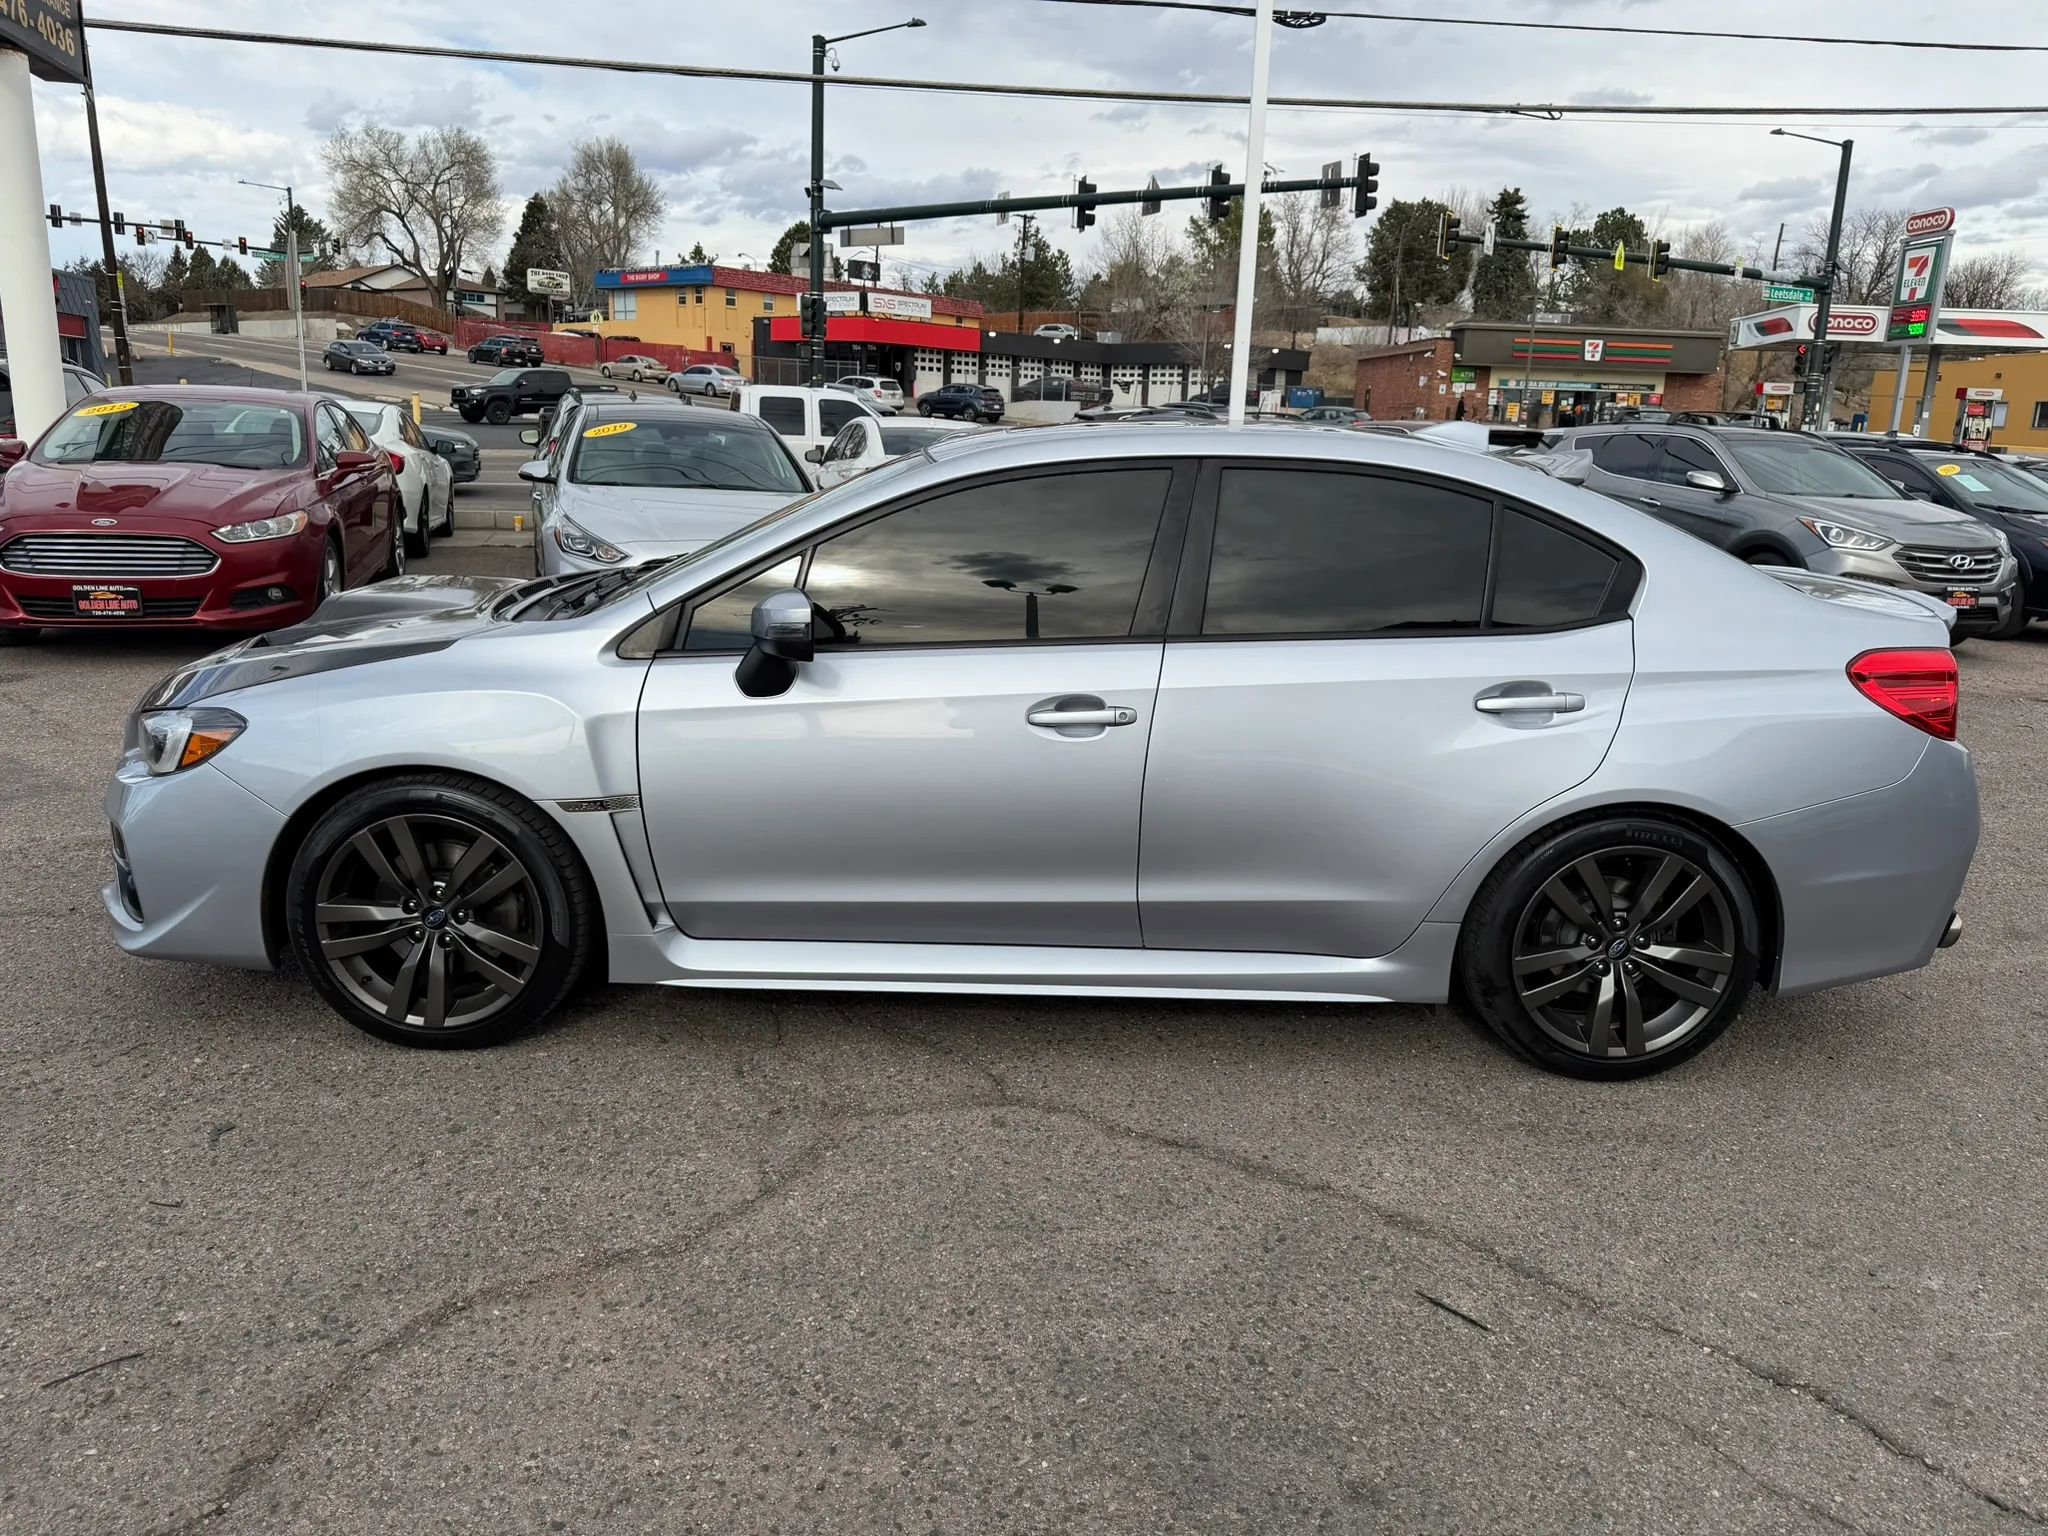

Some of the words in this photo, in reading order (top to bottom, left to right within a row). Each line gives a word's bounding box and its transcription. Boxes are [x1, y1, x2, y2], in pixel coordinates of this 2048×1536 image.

[1770, 288, 1804, 301] Leetsdale
[1827, 317, 1874, 330] onoco
[86, 404, 128, 415] 2015
[592, 423, 628, 436] 2019
[79, 600, 105, 610] GOLDEN
[105, 600, 120, 610] LINE
[121, 600, 138, 610] AUTO
